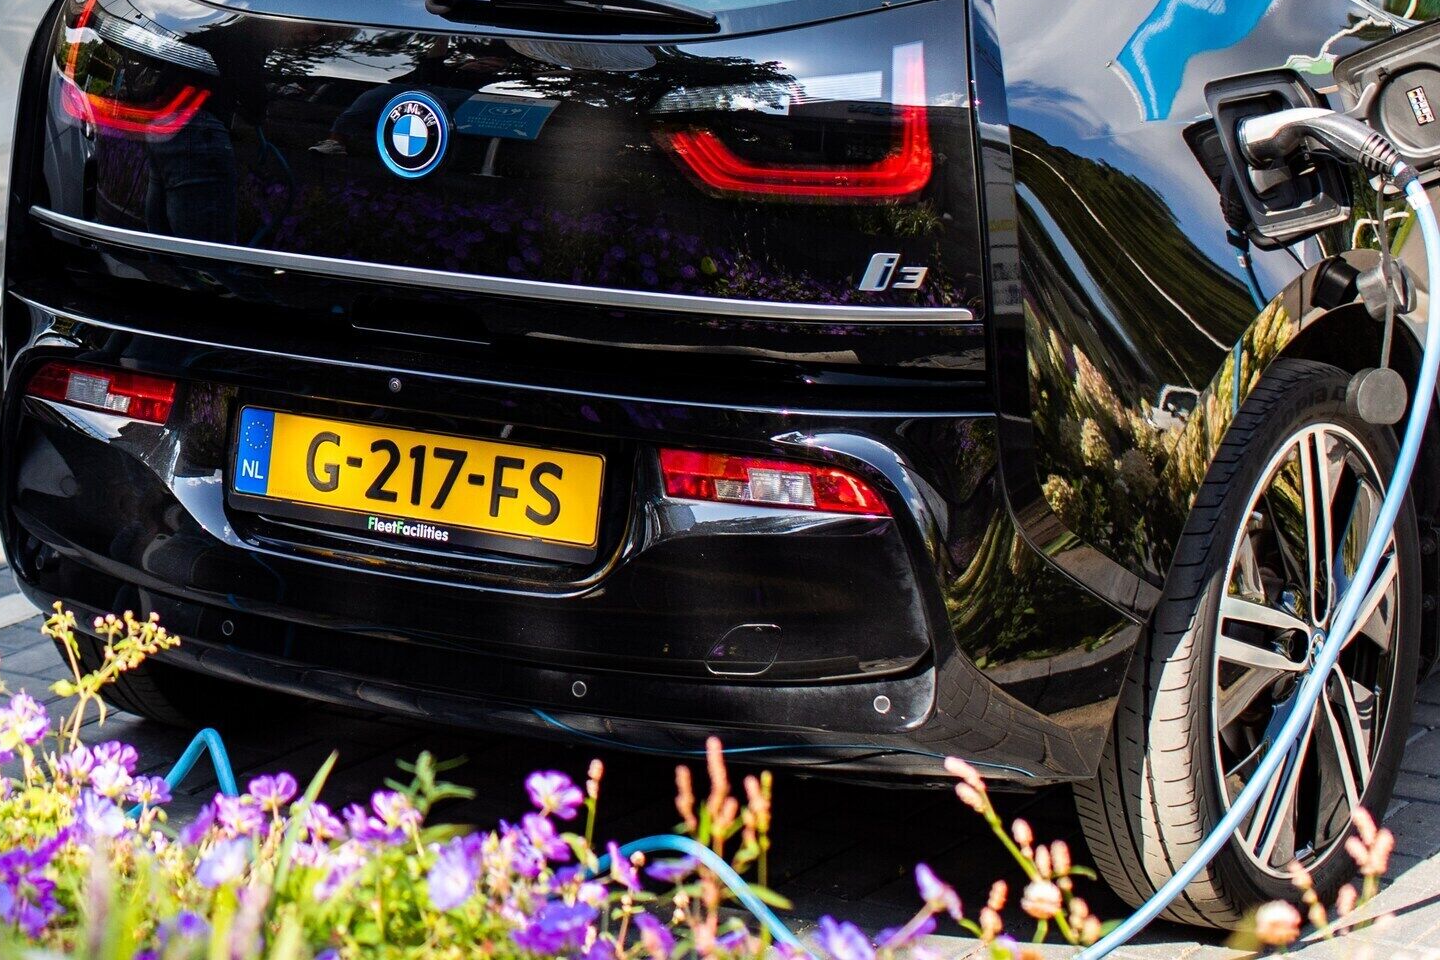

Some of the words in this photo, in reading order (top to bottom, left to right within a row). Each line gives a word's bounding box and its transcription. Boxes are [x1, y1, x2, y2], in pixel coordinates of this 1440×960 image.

[389, 103, 437, 127] BMW
[859, 252, 928, 291] i3
[241, 457, 264, 481] NL
[306, 431, 564, 527] G-217-FS
[367, 516, 449, 542] FleetFacilities
